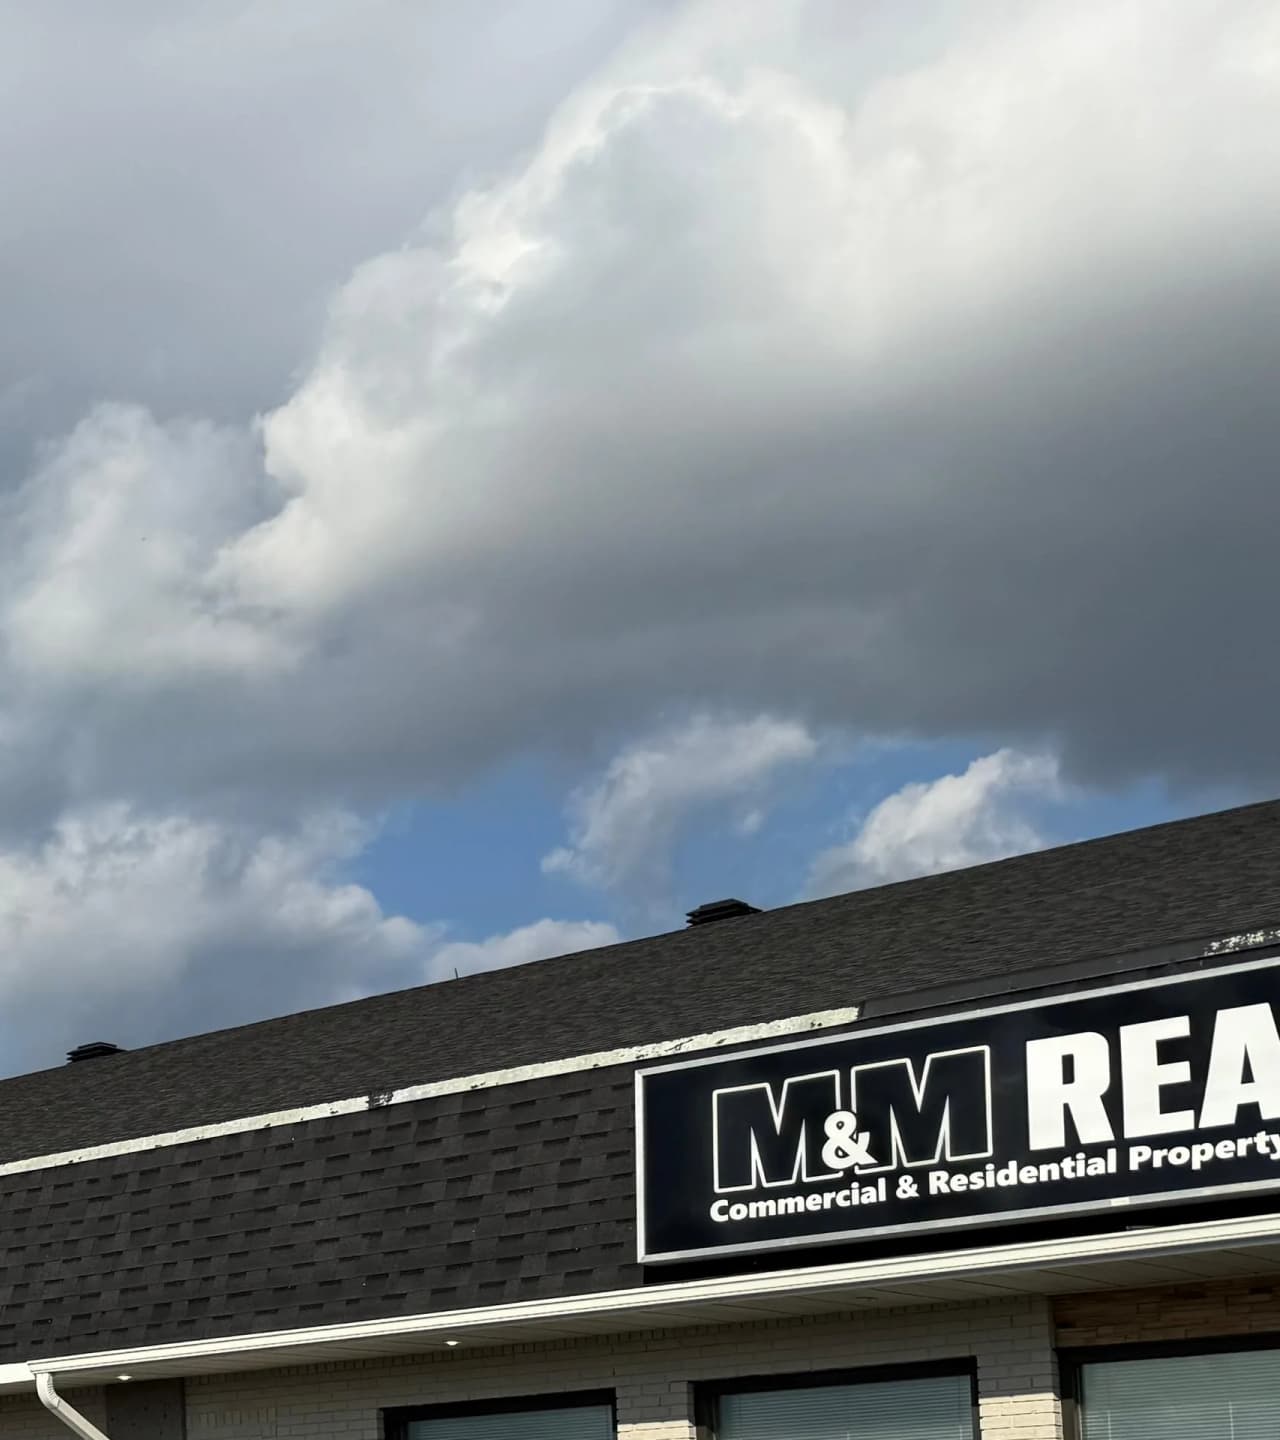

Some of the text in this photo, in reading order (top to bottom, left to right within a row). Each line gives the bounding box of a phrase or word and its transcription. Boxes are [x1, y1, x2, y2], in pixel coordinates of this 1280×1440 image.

[712, 1001, 1280, 1194] M&M REA
[709, 1129, 1280, 1223] Commercial & Residential Property
